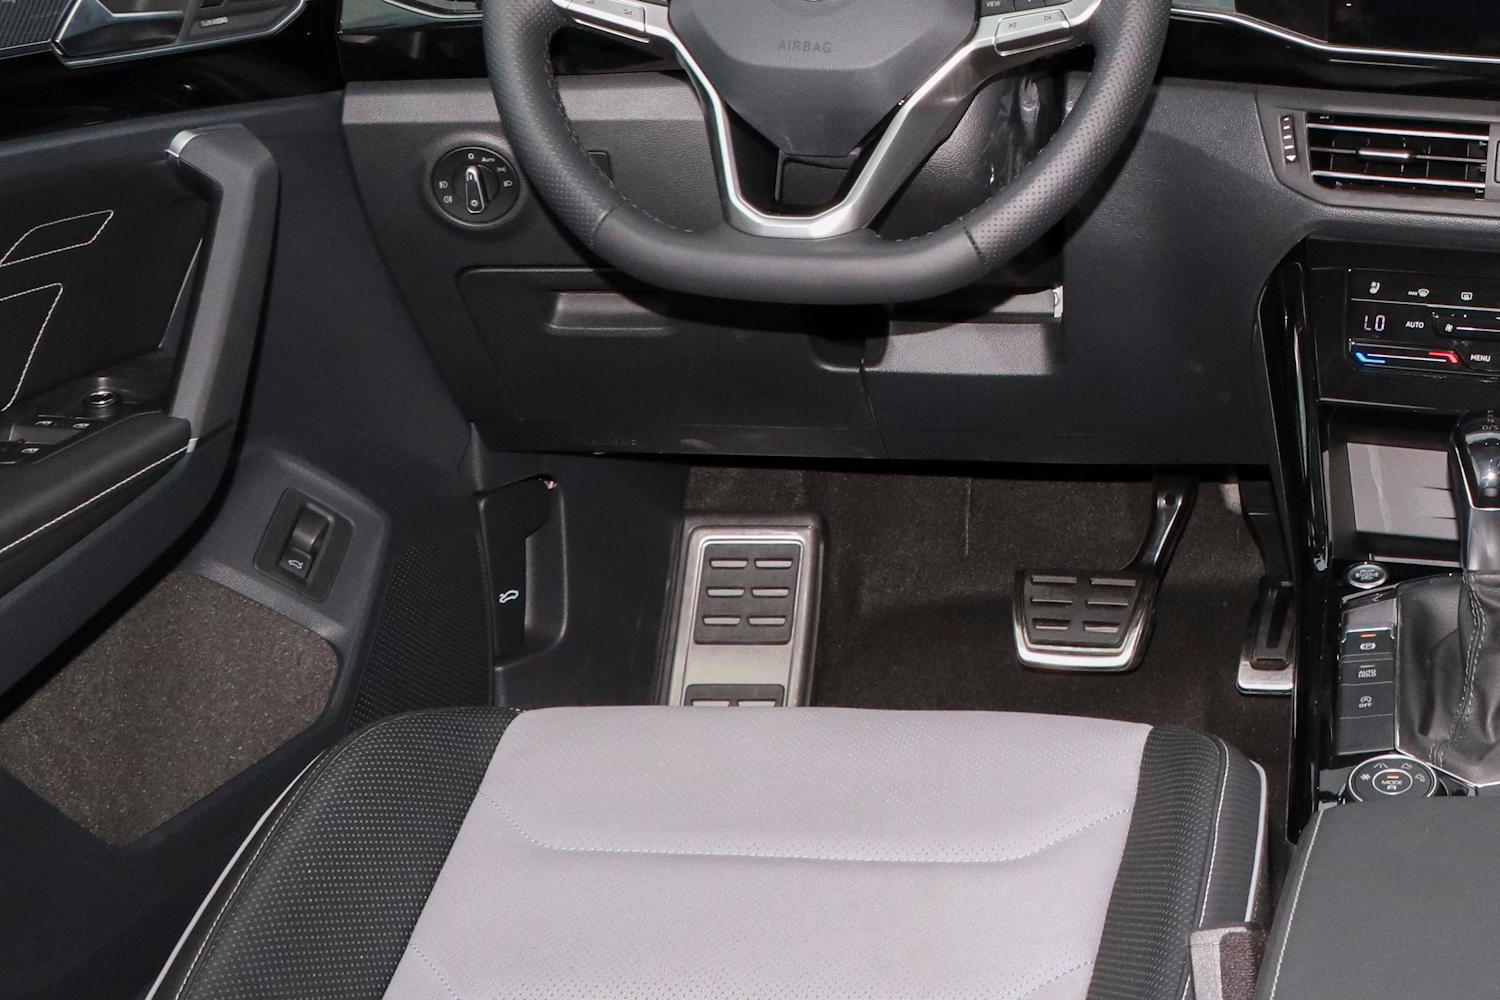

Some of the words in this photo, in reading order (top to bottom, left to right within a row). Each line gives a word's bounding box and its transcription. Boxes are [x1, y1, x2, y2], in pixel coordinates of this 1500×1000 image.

[777, 39, 833, 53] AIRBAG
[1405, 321, 1425, 329] AUTO
[1470, 354, 1491, 362] MENU
